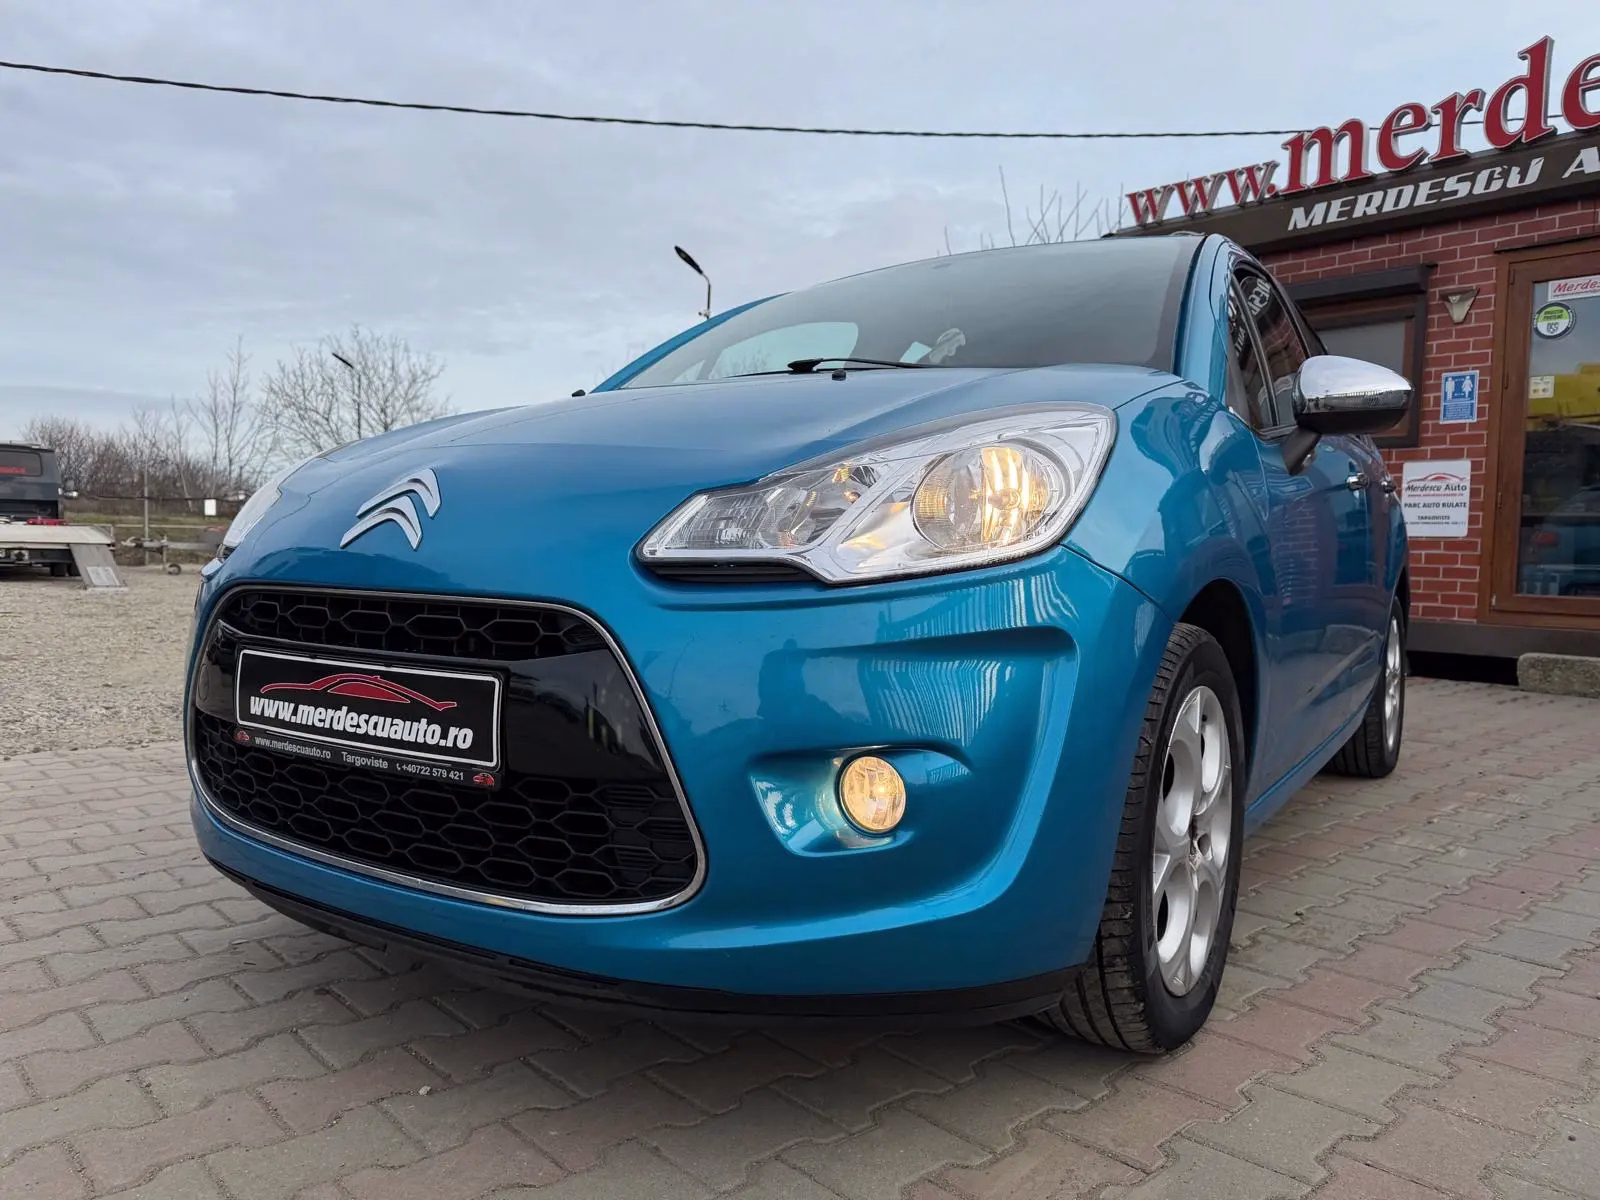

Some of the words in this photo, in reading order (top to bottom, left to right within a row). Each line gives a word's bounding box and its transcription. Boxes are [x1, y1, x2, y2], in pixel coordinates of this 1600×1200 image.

[1287, 156, 1545, 231] MERDESCU
[1405, 484, 1442, 492] Merdescu
[1444, 483, 1467, 492] Auto
[250, 695, 474, 750] www.merdescuauto.ro
[254, 736, 331, 759] www.merdescuauto.ro
[341, 751, 389, 769] Targoviste
[401, 763, 431, 776] +40722
[432, 768, 447, 779] 579
[448, 771, 465, 781] 421
